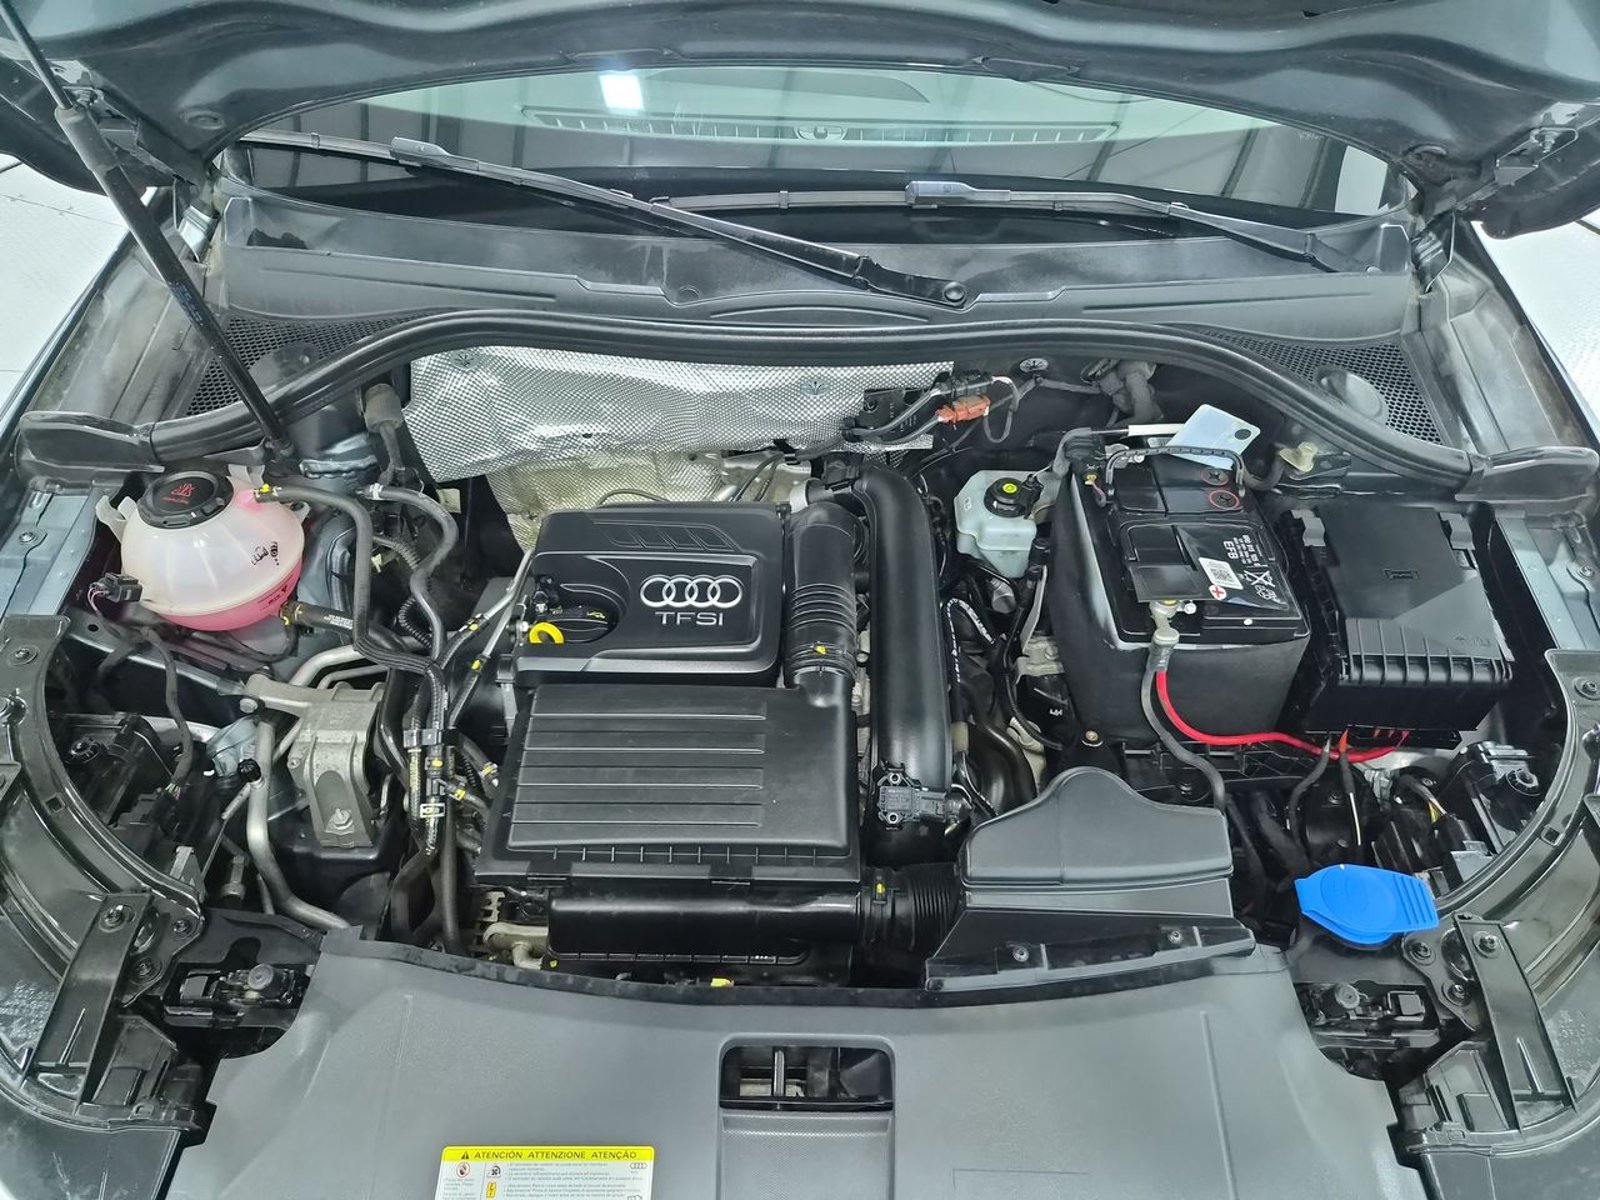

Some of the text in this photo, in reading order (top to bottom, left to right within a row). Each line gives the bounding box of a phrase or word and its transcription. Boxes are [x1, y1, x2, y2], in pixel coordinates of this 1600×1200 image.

[1223, 541, 1239, 560] EFB
[655, 611, 724, 626] TFSI
[474, 1150, 637, 1161] ATENCIÓN ATTENZIONE ATENÇÃO
